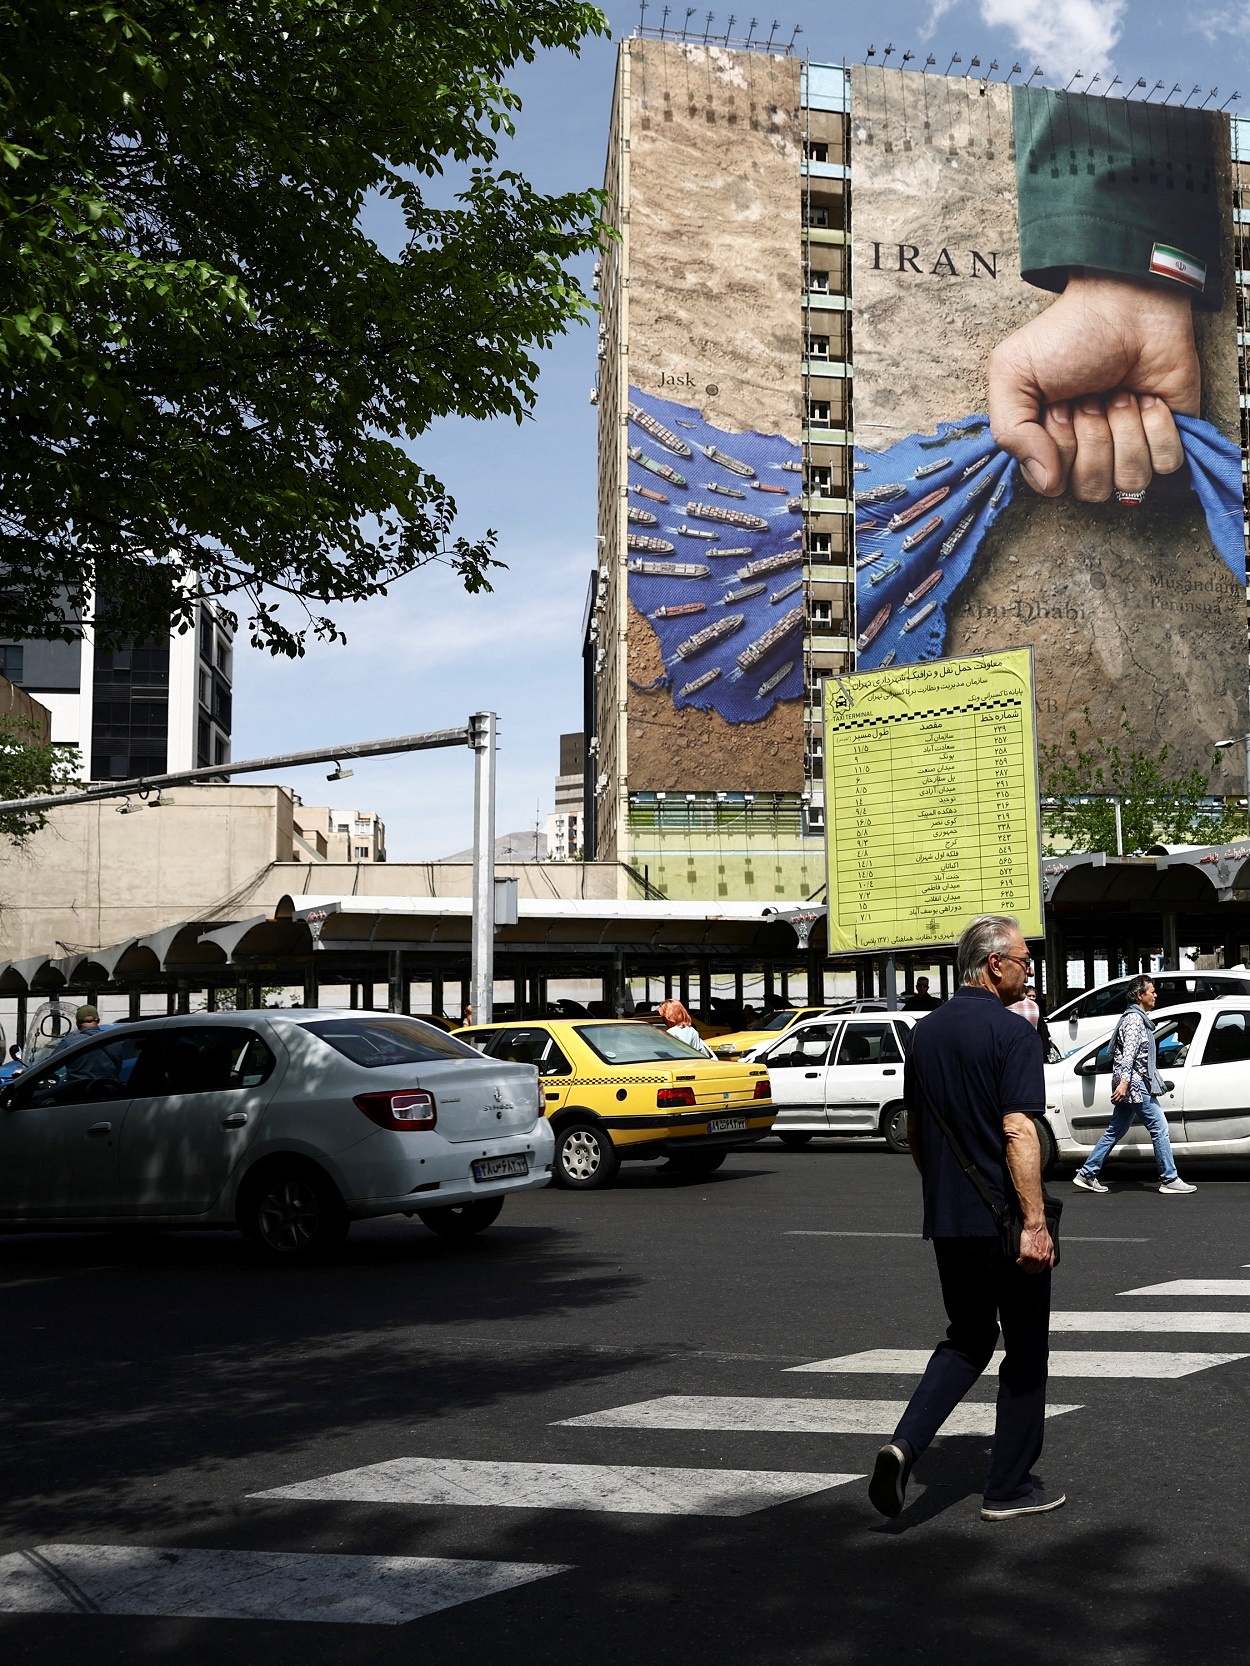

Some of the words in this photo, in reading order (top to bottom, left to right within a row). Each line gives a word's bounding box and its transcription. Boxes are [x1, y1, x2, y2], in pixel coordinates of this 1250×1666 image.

[870, 241, 1000, 280] IRAN
[657, 371, 696, 388] Jask
[973, 659, 1002, 670] معاونت
[939, 666, 953, 678] نقل
[955, 664, 971, 675] حمل
[907, 670, 932, 680] ترافیک
[873, 674, 906, 686] شهرداری
[965, 677, 988, 687] سازمان
[852, 680, 871, 690] تهران
[940, 681, 964, 690] مدیریت
[1008, 688, 1023, 696] پایانه
[967, 694, 980, 702] ونک
[844, 711, 873, 721] TERMINAL
[980, 713, 994, 723] خط
[994, 709, 1019, 722] شماره
[919, 722, 943, 731] مقصد
[872, 728, 889, 739] طول
[925, 734, 933, 742] آب
[934, 732, 954, 742] سازمان
[852, 734, 871, 743] مسیر
[923, 744, 934, 753] آباد
[934, 743, 955, 752] سعادت
[939, 753, 955, 761] پونک
[937, 765, 955, 773] میدان
[922, 775, 946, 785] ستارخان
[948, 774, 956, 782] پل
[919, 785, 937, 797] آزادی
[938, 786, 956, 794] میدان
[938, 796, 956, 804] توحید
[917, 810, 936, 818] المپیک
[937, 807, 957, 815] دهکده
[944, 817, 957, 826] کوی
[933, 830, 958, 838] جمهوری
[944, 839, 958, 849] کرج
[915, 854, 933, 862] شهران
[934, 852, 944, 860] اول
[940, 862, 959, 871] اکباتان
[934, 873, 945, 881] آباد
[921, 885, 941, 894] فاطمی
[942, 883, 960, 891] میدان
[924, 895, 941, 903] انقلاب
[943, 894, 961, 902] میدان
[859, 902, 868, 910] ۱۵
[939, 904, 962, 914] دوراهی
[909, 907, 920, 916] آباد
[921, 907, 938, 916] یوسف
[891, 936, 913, 944] هماهنگی
[915, 933, 933, 941] نظارت
[938, 932, 955, 940] شهری
